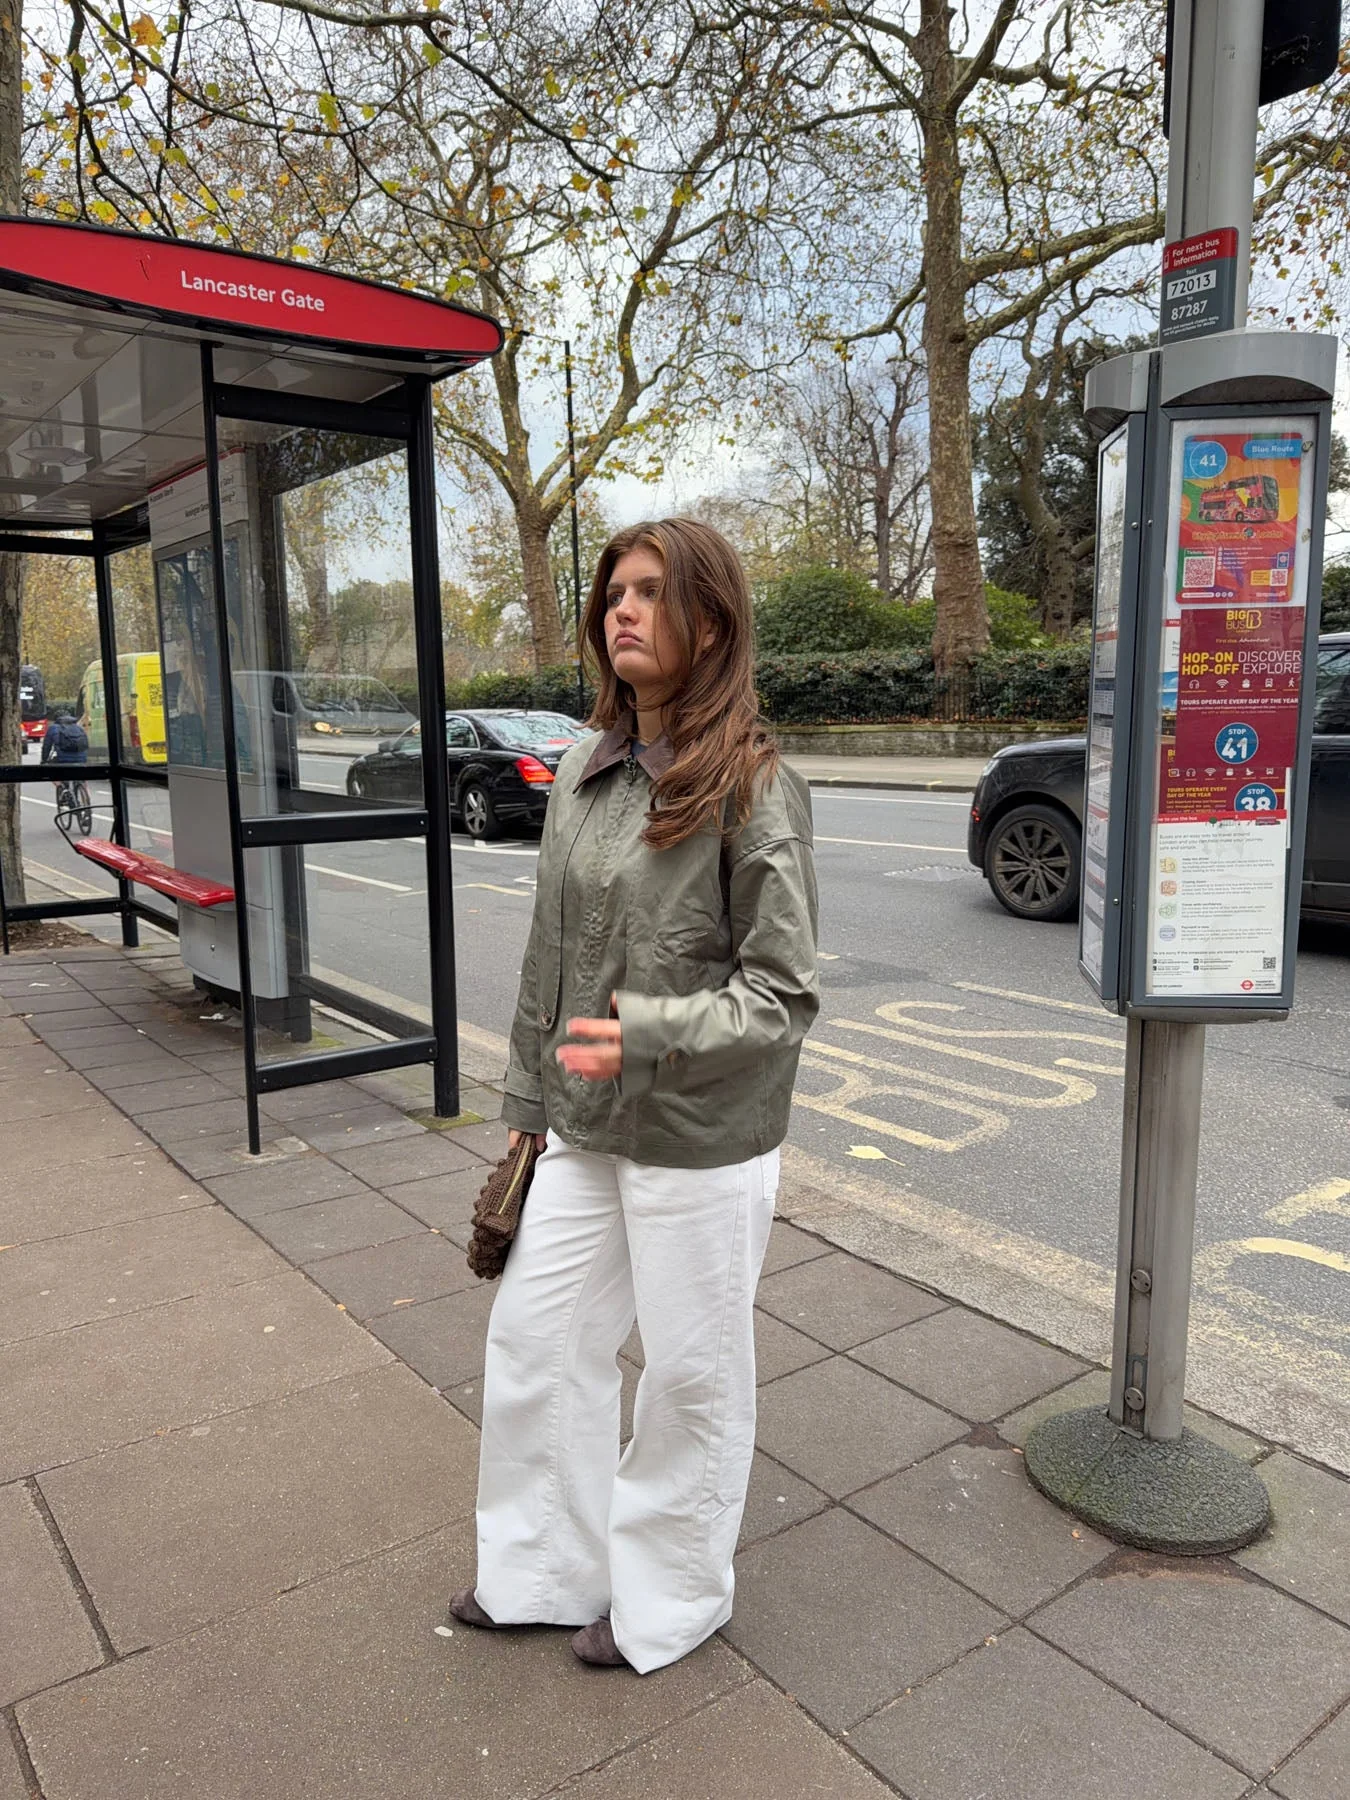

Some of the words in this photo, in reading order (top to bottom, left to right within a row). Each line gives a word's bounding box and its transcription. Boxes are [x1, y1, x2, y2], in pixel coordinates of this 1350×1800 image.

[1172, 249, 1184, 257] For
[1186, 242, 1203, 253] next
[1205, 238, 1220, 248] bus
[1174, 248, 1217, 266] information
[181, 270, 276, 303] Lancaster
[281, 289, 325, 312] Gate
[1171, 274, 1211, 296] 72013
[1171, 300, 1208, 320] 87287
[1200, 454, 1218, 467] 41
[1226, 610, 1246, 620] BIG
[1226, 621, 1246, 630] BUS
[1182, 652, 1234, 663] HOP-ON
[1238, 650, 1302, 663] DISCOVER
[1182, 664, 1240, 675] HOP-OFF
[1242, 662, 1301, 674] EXPLORE
[1221, 737, 1248, 759] 41
[1240, 797, 1271, 811] 38
